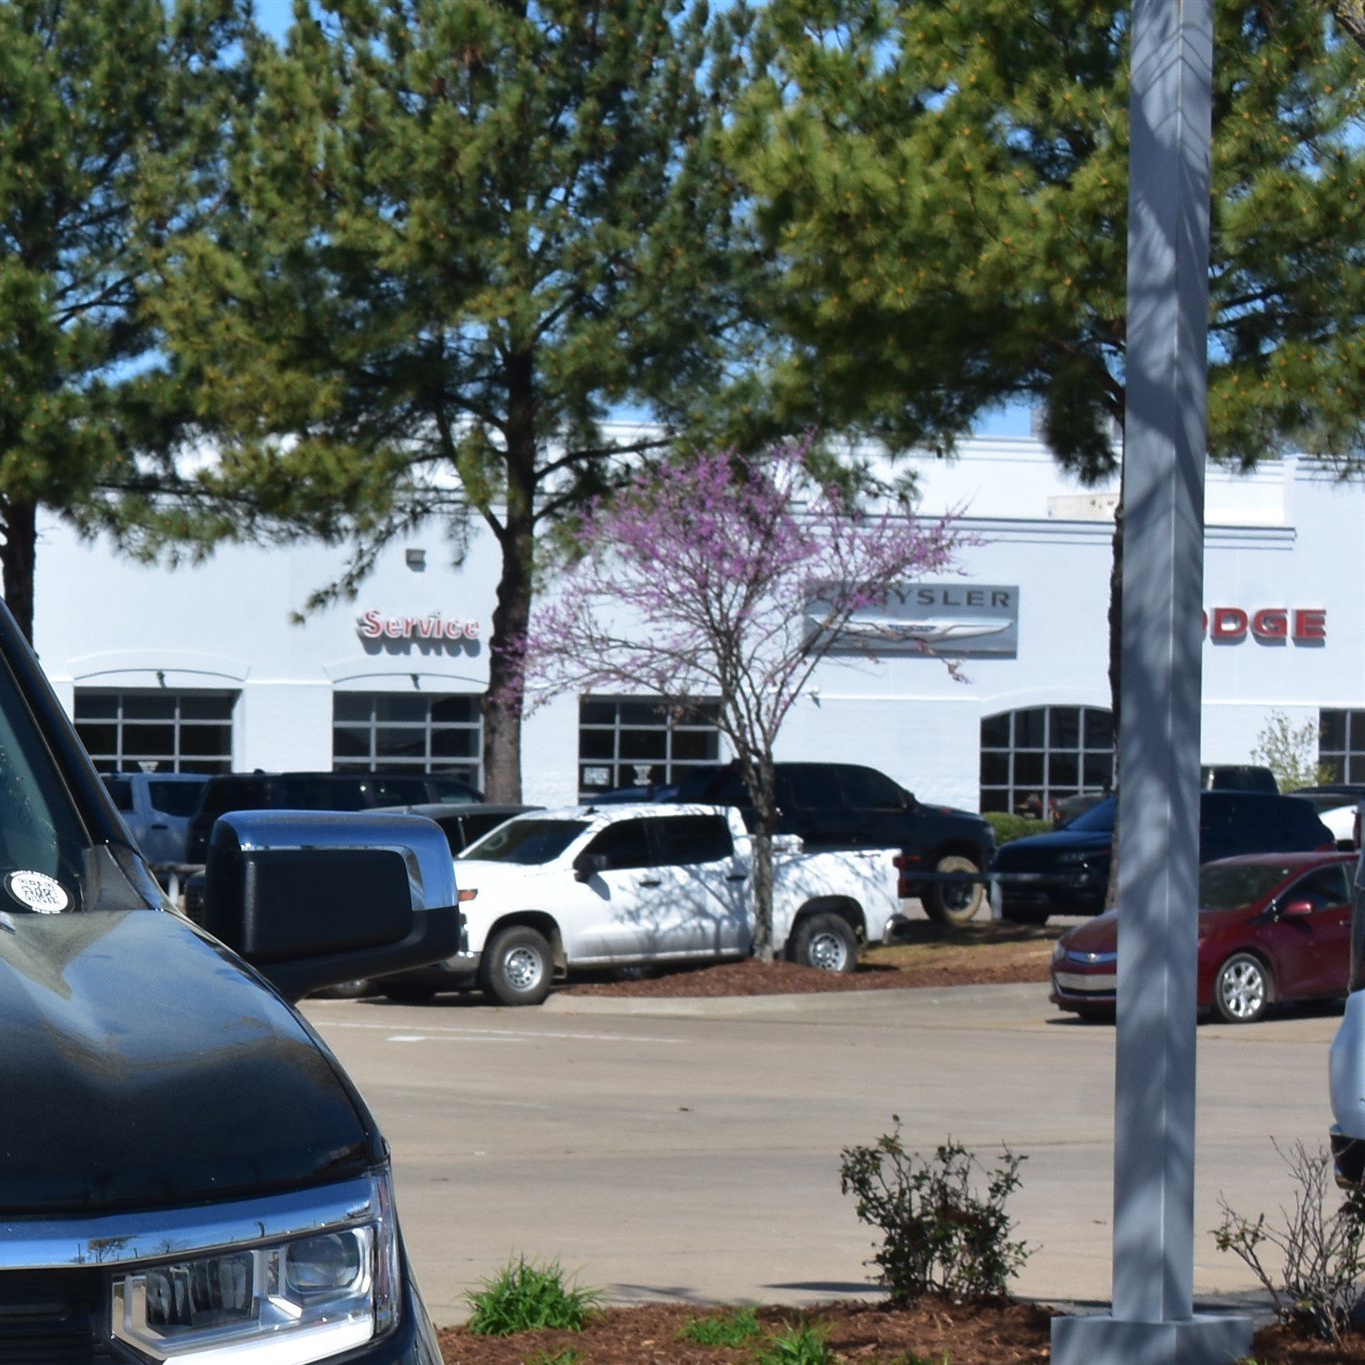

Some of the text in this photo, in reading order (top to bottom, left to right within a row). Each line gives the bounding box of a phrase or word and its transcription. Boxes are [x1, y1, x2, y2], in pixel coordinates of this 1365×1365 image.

[817, 588, 1010, 608] CYSLER
[363, 608, 481, 639] Service
[1203, 608, 1327, 640] DGE
